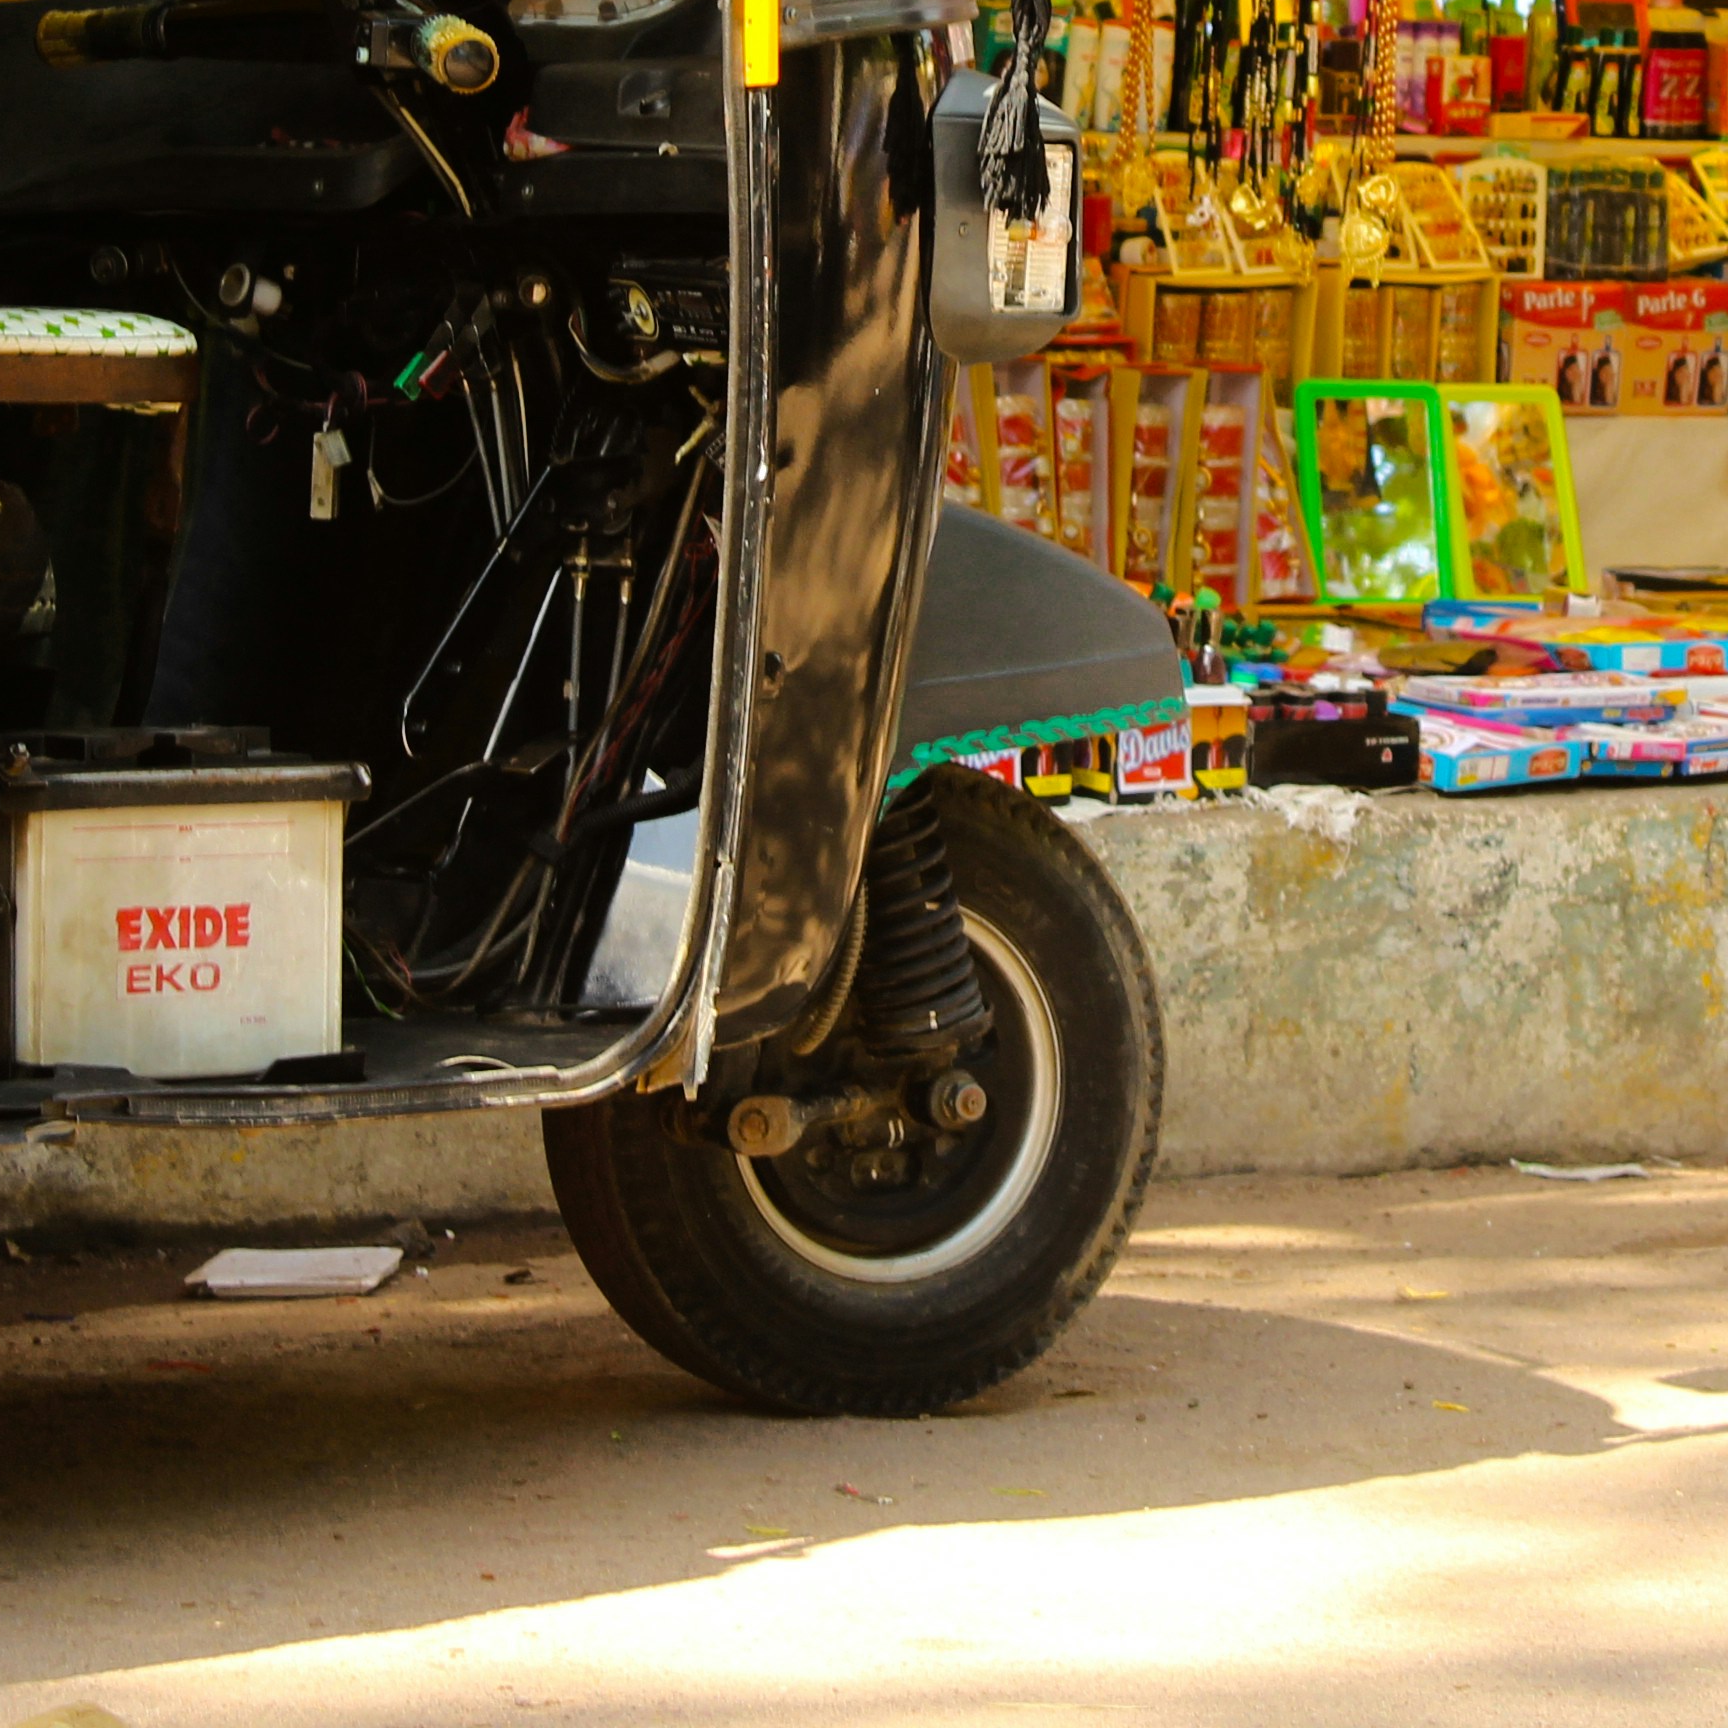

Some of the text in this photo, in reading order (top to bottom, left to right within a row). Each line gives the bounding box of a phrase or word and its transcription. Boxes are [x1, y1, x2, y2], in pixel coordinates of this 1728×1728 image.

[1119, 721, 1193, 772] Davis
[115, 902, 251, 953] EXIDE
[125, 962, 222, 995] EKO
